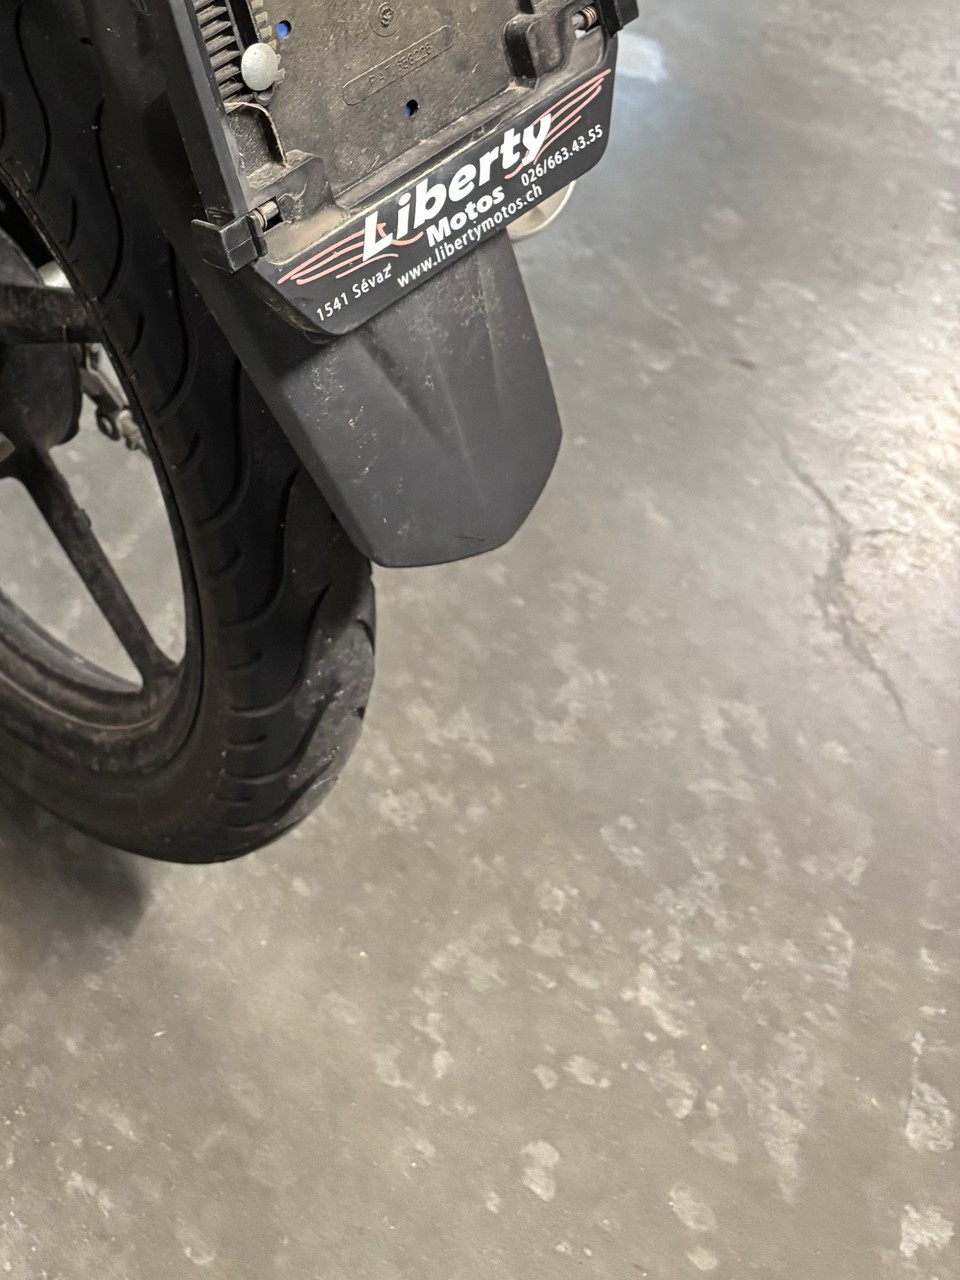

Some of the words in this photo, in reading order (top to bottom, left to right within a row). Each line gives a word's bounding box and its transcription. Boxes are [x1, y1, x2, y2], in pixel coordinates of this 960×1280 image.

[521, 124, 603, 186] 026/663.43.55
[363, 113, 551, 261] Liberty
[426, 186, 505, 247] Motos
[397, 183, 542, 287] www.libertymotos.ch
[316, 292, 348, 321] 1541
[352, 263, 392, 298] Sévaz
